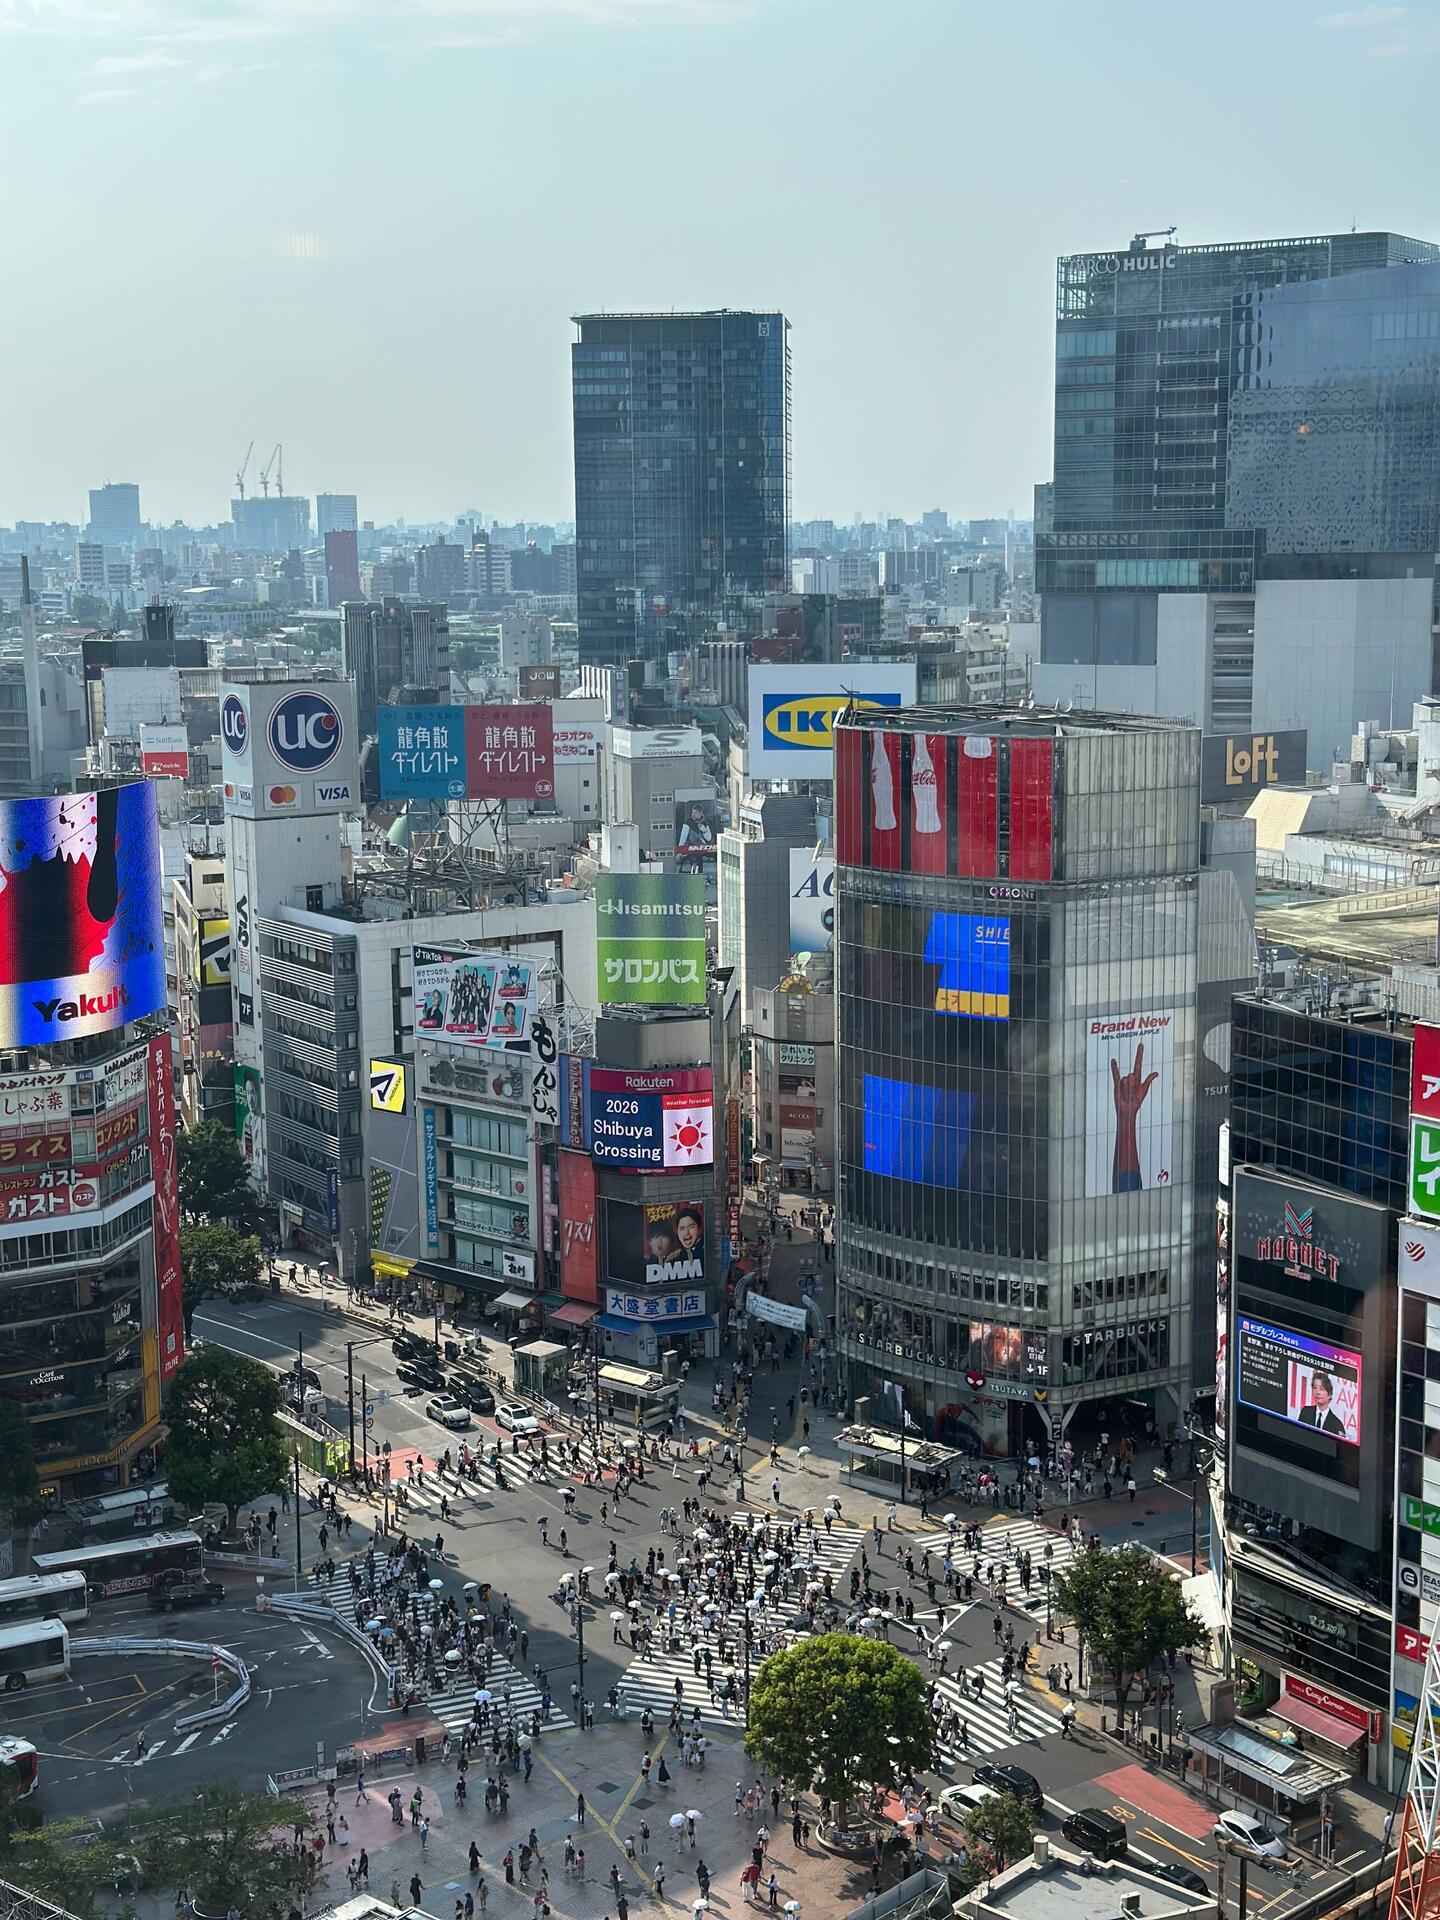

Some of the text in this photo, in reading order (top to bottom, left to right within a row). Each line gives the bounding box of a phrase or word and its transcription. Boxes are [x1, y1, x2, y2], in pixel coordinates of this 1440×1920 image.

[1070, 254, 1176, 275] PARCO HULIC
[397, 726, 449, 749] 龍角散
[485, 726, 536, 749] 龍角散
[391, 751, 459, 773] ダイレクト
[479, 751, 546, 773] ダイレクト
[240, 790, 251, 801] VISA
[318, 787, 349, 800] VISA
[598, 898, 704, 917] Hisamitsu
[422, 952, 443, 962] TikTok
[604, 957, 700, 984] サロンパス
[32, 983, 129, 1023] Yakult
[241, 1002, 252, 1015] 7F
[1090, 1016, 1170, 1035] Brand New
[1115, 1030, 1138, 1039] GREEN
[1138, 1028, 1160, 1036] APPLE
[781, 1055, 815, 1063] クリニック
[788, 1046, 815, 1055] れいわ
[531, 1016, 558, 1123] もんじゃ
[625, 1076, 675, 1089] Rakuten
[4, 1092, 63, 1115] しゃぶ葉
[606, 1099, 639, 1115] 2026
[97, 1113, 137, 1147] コンタクト
[593, 1119, 653, 1139] Shibuya
[130, 1142, 149, 1164] ガスト
[593, 1141, 662, 1161] Crossing
[39, 1168, 83, 1189] ガスト
[9, 1192, 65, 1218] ガスト
[75, 1193, 94, 1202] ガスト
[1257, 1235, 1340, 1283] MAGNET
[646, 1259, 703, 1283] DMM
[611, 1294, 700, 1315] 大盛堂書店
[1073, 1320, 1167, 1346] STARBUCKS
[858, 1333, 946, 1366] STARBUCKS
[1037, 1365, 1048, 1375] 1F
[989, 1384, 1029, 1397] TSUTAYA
